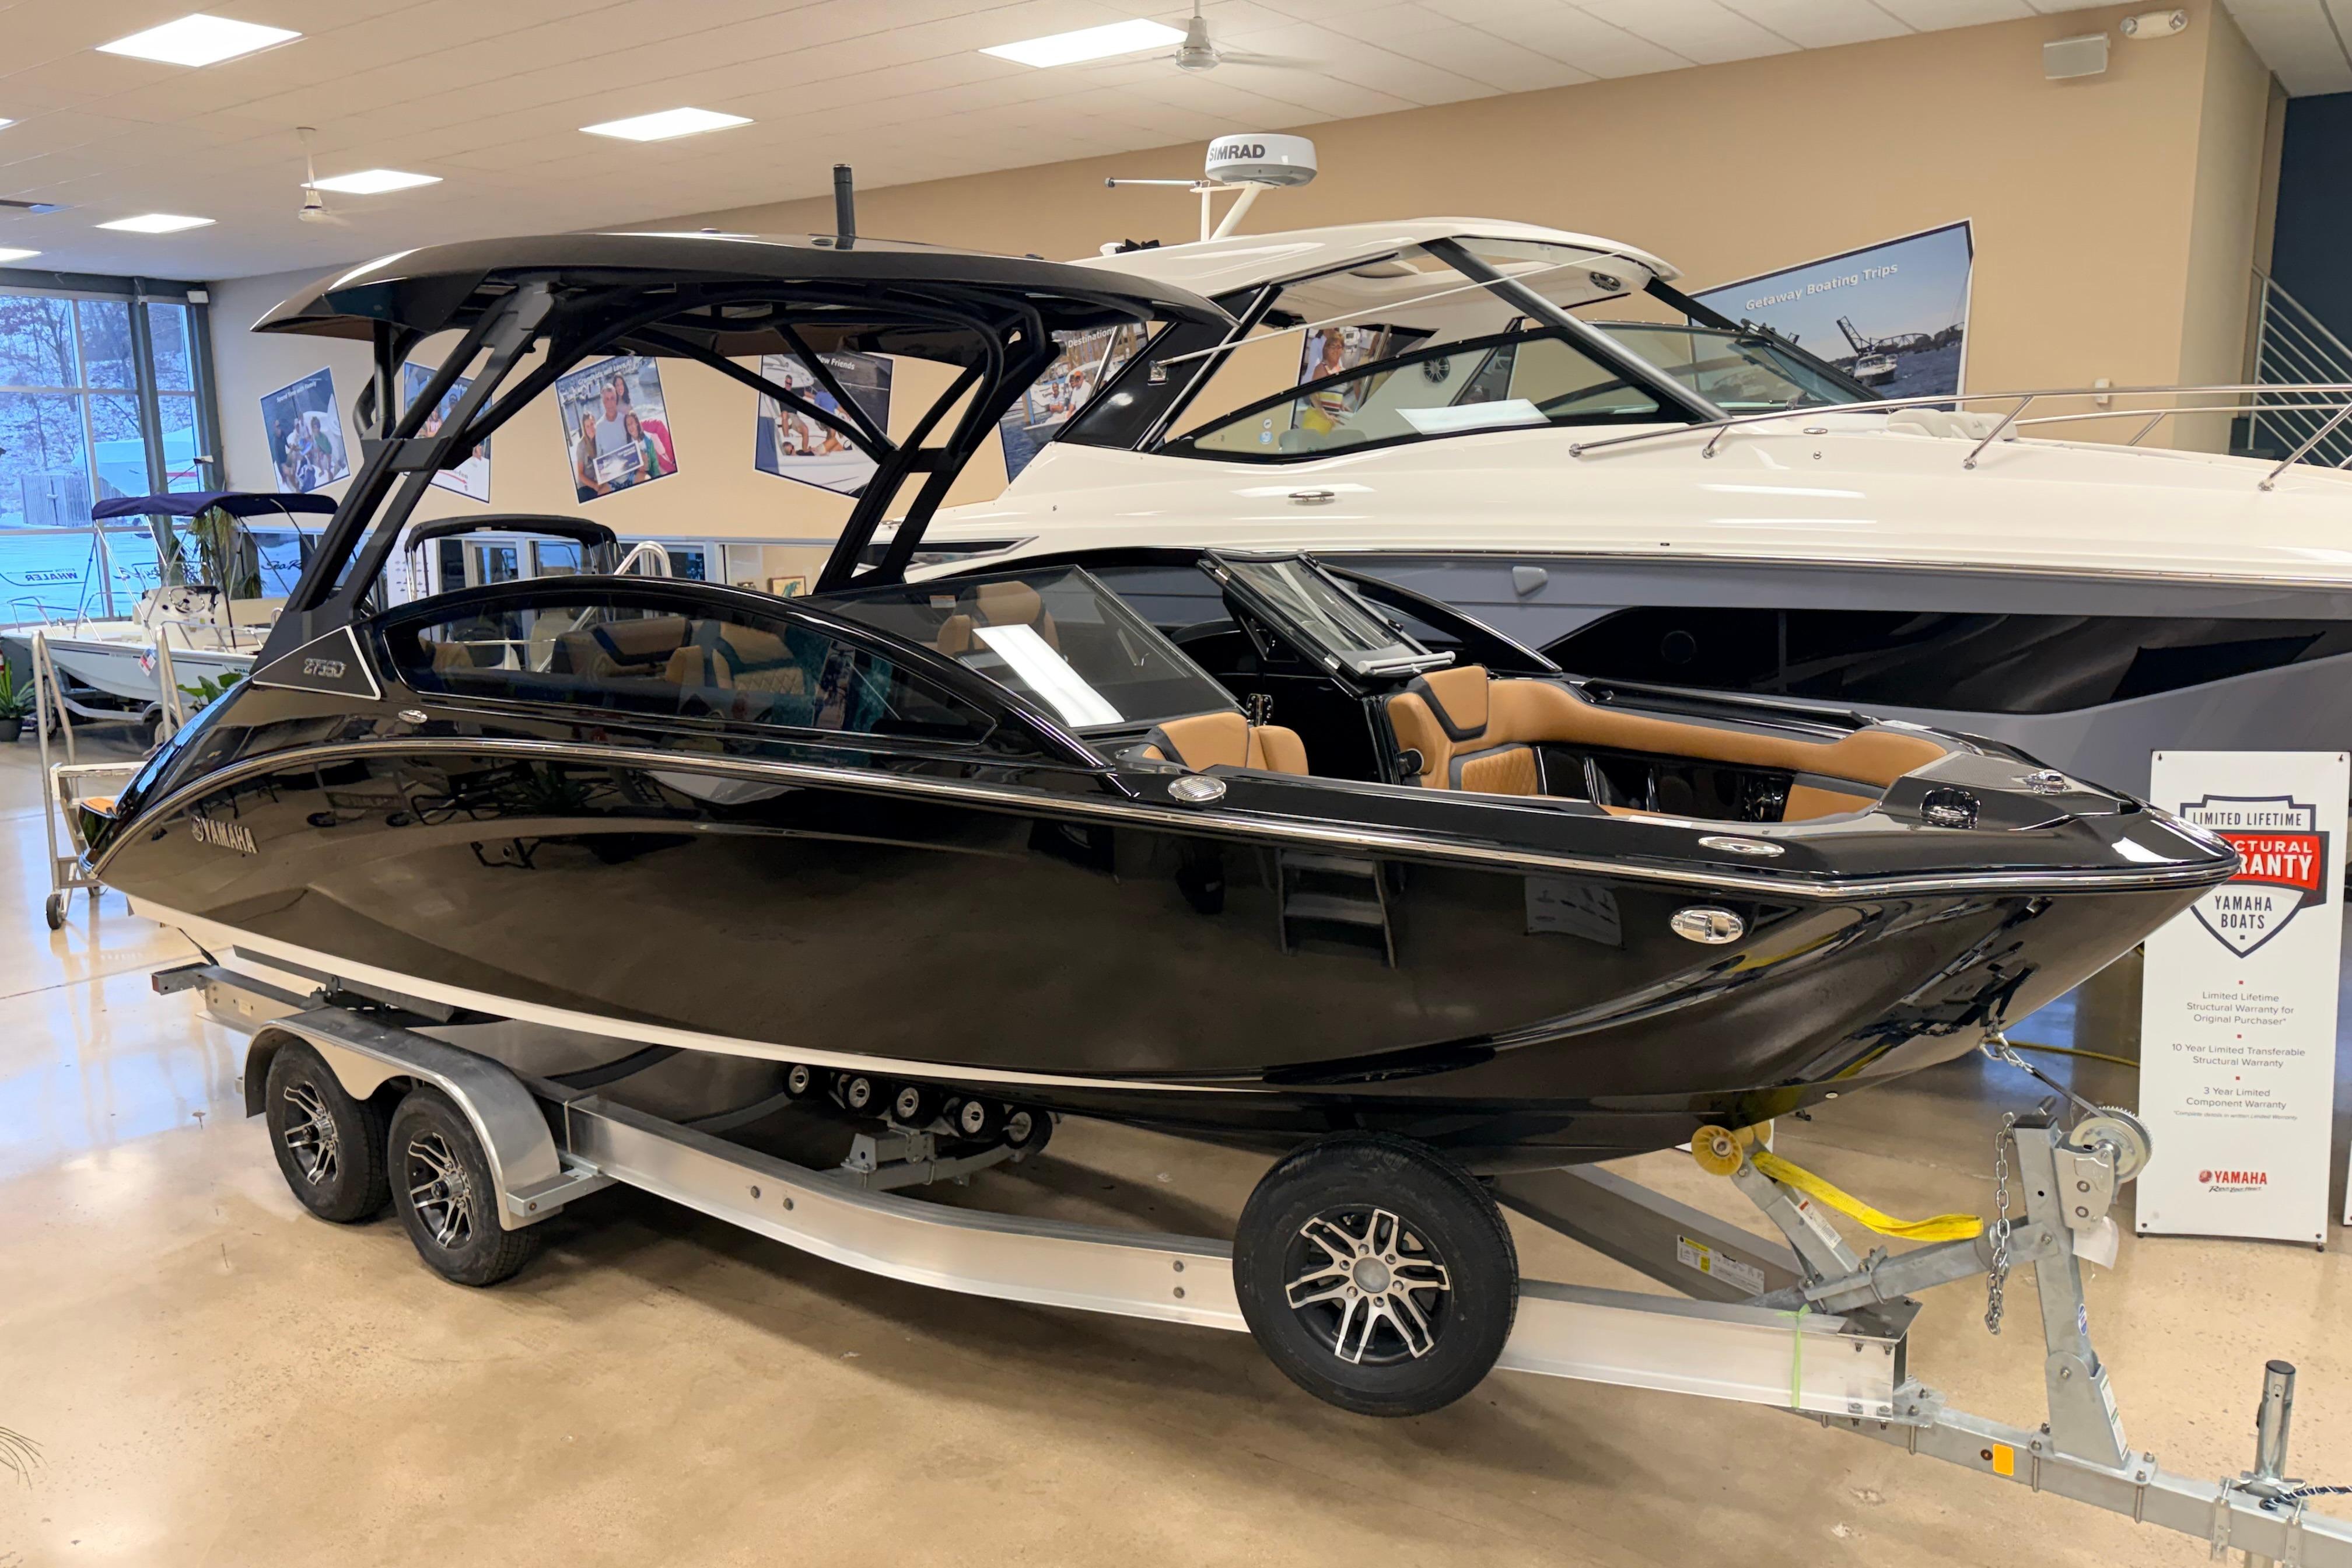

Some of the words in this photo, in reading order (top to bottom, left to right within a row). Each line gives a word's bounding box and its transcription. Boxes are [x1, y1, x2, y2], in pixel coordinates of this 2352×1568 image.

[1209, 145, 1265, 162] SIMRAD
[1745, 289, 1803, 310] Getaway
[1806, 274, 1859, 295] Boating
[1863, 264, 1898, 280] Trips
[831, 358, 855, 370] Friends
[2193, 813, 2241, 825] LIMITED
[2247, 813, 2301, 826] LIFETIME
[201, 817, 257, 853] YAMAHA
[2234, 840, 2312, 853] CTURAL
[2238, 854, 2313, 881] RANTY
[2215, 896, 2272, 911] YAMAHA
[2221, 914, 2264, 929] BOATS
[2202, 991, 2238, 1000] Limited
[2241, 993, 2280, 1002] Lifetime
[2187, 1002, 2232, 1012] Structural
[2235, 1005, 2278, 1015] Warranty
[2193, 1014, 2231, 1024] Original
[2185, 1044, 2206, 1052] Year
[2209, 1045, 2244, 1054] Limited
[2247, 1047, 2305, 1056] Transferable
[2193, 1056, 2239, 1065] Structural
[2242, 1058, 2284, 1068] Warranty
[2213, 1087, 2233, 1096] Year
[2236, 1088, 2270, 1097] Limited
[2186, 1097, 2242, 1107] Component
[2245, 1100, 2287, 1110] Warranty
[2214, 1171, 2267, 1184] YAMAHA
